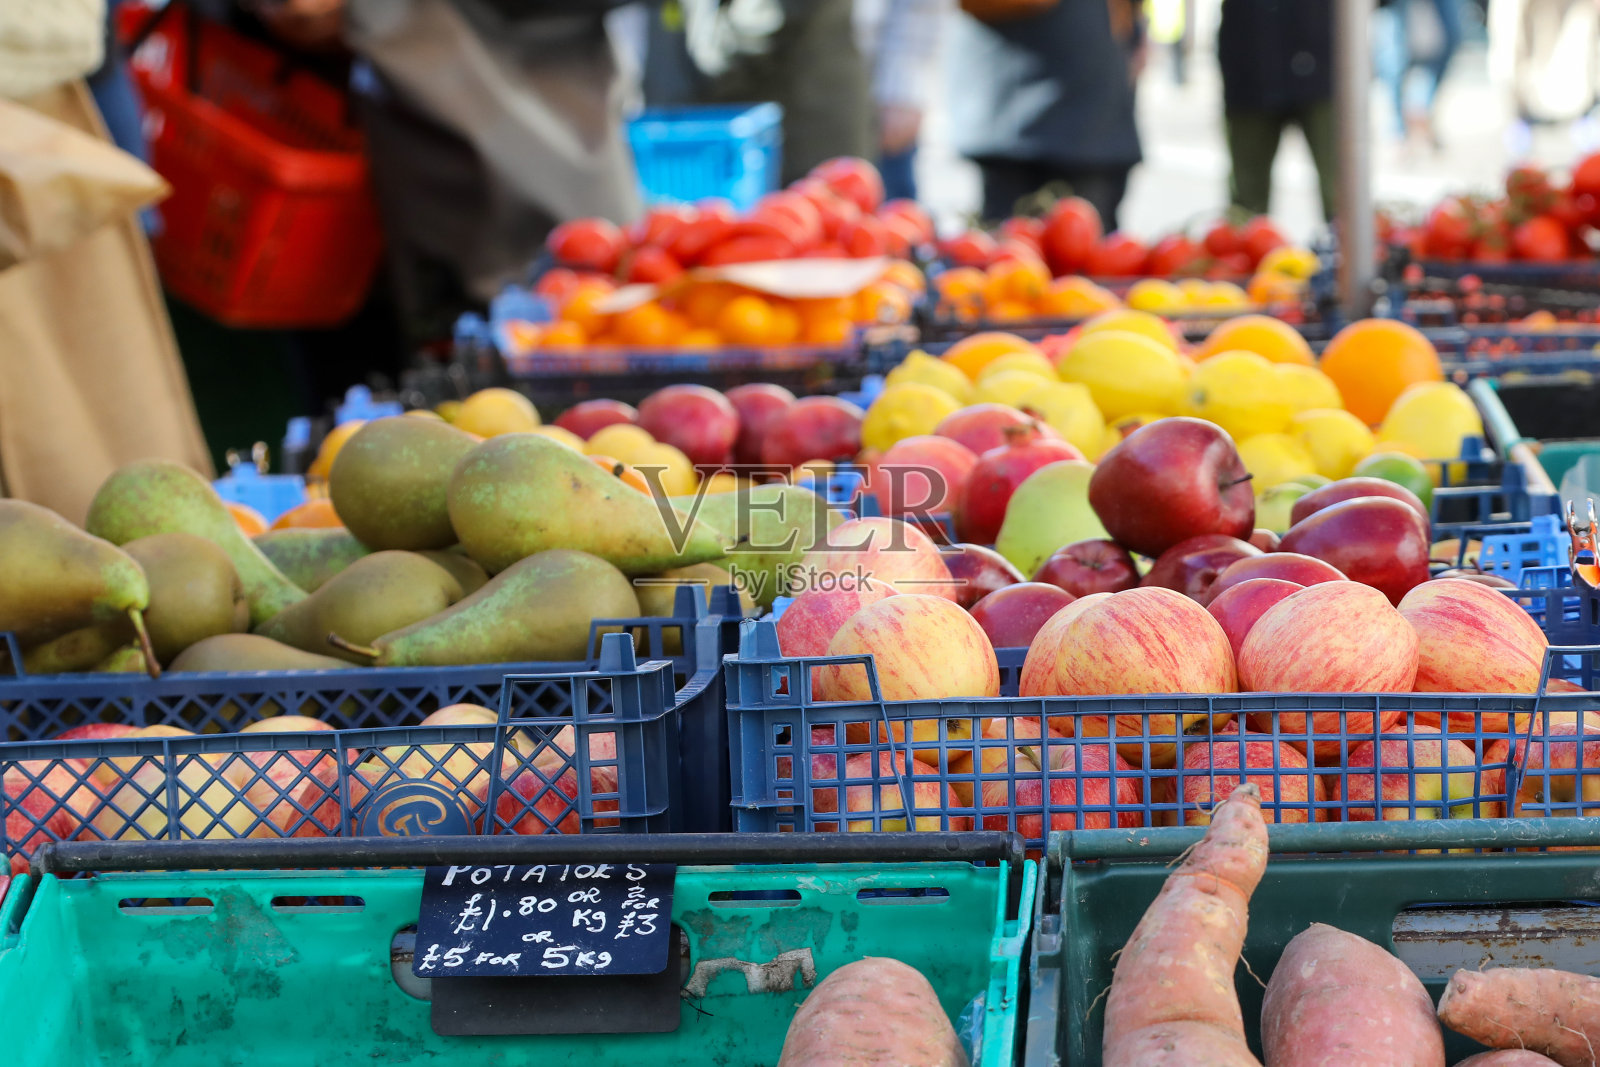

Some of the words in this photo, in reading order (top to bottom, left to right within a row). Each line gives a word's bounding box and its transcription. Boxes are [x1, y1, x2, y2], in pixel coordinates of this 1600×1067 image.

[453, 893, 558, 934] £1.80
[567, 887, 602, 904] OR
[621, 897, 660, 909] FOR
[522, 930, 555, 944] OR
[614, 911, 659, 940] £3
[418, 943, 472, 971] £5
[475, 951, 522, 967] FOR
